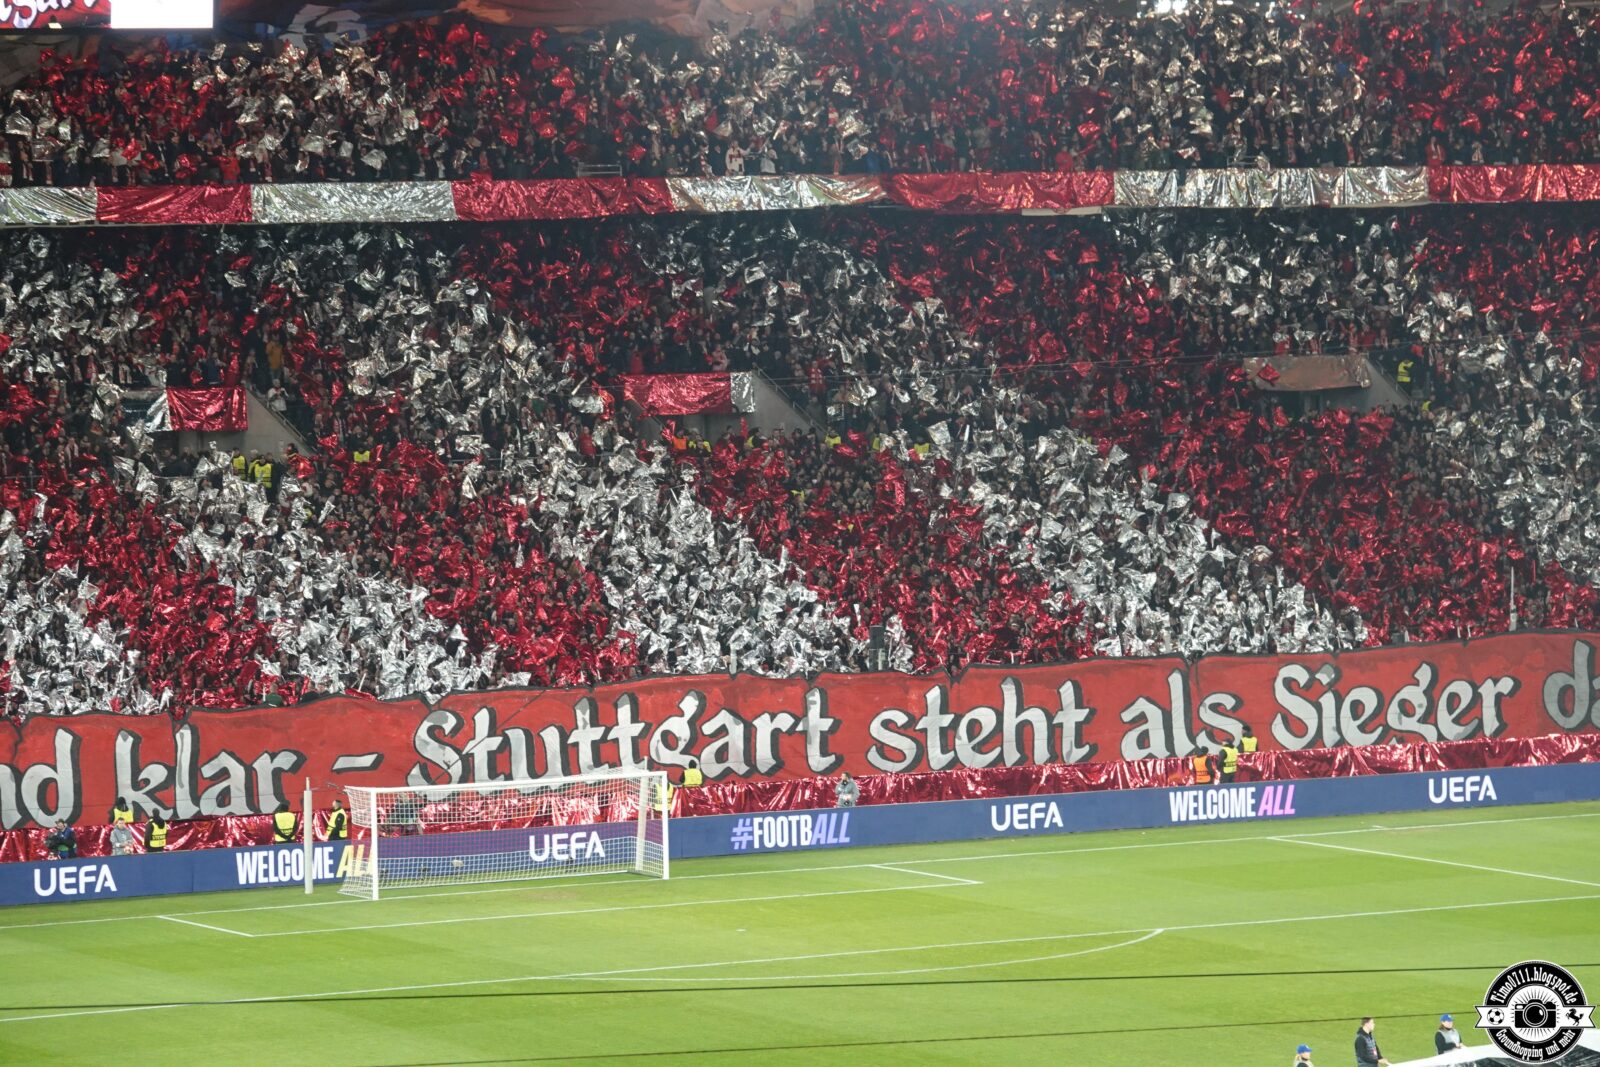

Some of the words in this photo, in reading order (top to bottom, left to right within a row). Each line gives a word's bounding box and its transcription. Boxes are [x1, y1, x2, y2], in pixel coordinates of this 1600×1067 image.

[115, 725, 297, 821] klar
[406, 689, 837, 802] Stuttgart
[866, 676, 1091, 771] steht
[1120, 669, 1243, 760] als
[1271, 662, 1515, 748] Sieger
[1544, 640, 1600, 729] d
[1169, 787, 1256, 822] WELCOME
[1258, 785, 1295, 816] ALL
[1428, 775, 1497, 804] UEFA
[731, 813, 850, 850] #FOOTBALL
[991, 802, 1063, 831] UEFA
[529, 831, 605, 861] UEFA
[34, 864, 117, 897] UEFA
